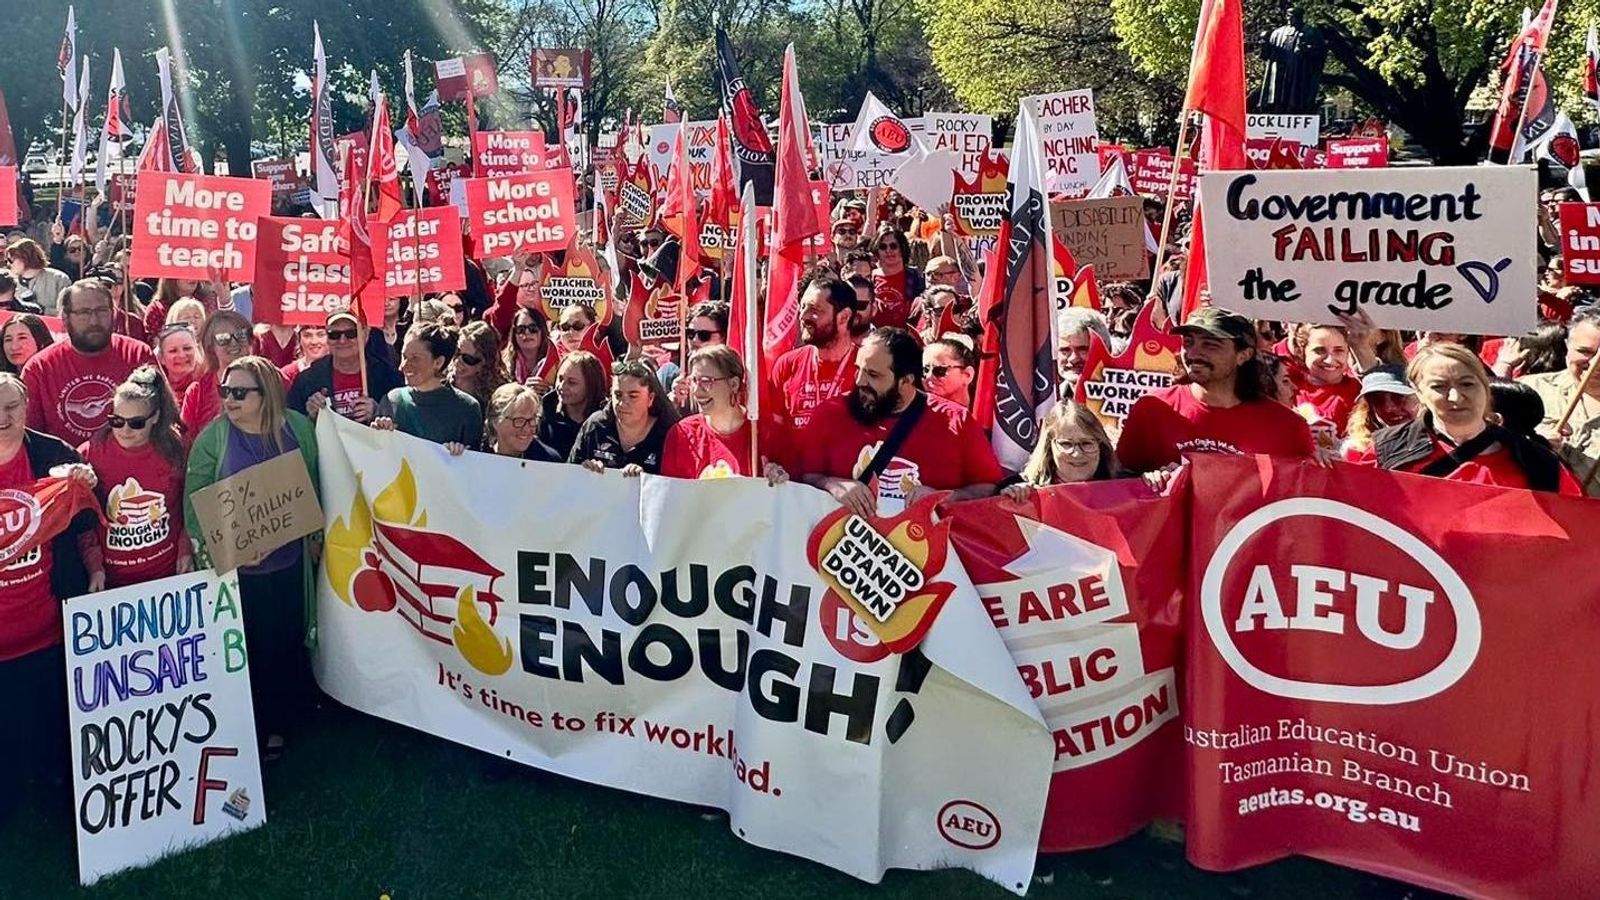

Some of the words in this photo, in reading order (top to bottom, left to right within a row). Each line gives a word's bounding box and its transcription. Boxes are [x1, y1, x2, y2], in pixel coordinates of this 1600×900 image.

[935, 118, 979, 133] ROCKY
[1044, 123, 1053, 133] BY
[1057, 121, 1075, 132] DAY
[1247, 115, 1313, 129] OCKLIFF
[487, 134, 530, 149] More
[688, 125, 716, 147] IX
[927, 132, 989, 152] AILED
[1043, 135, 1099, 158] NCHING
[479, 150, 518, 165] time
[521, 152, 539, 165] to
[1330, 142, 1381, 157] Support
[1343, 156, 1369, 166] new
[256, 163, 293, 175] Support
[433, 168, 462, 180] Safer
[1047, 157, 1078, 175] BAG
[1138, 165, 1188, 182] in-clas
[1147, 156, 1174, 168] Mor
[164, 179, 245, 212] More
[272, 182, 296, 191] chers
[487, 178, 550, 202] More
[1226, 173, 1482, 223] Government
[483, 198, 560, 225] school
[956, 195, 1004, 206] DROWN
[962, 207, 975, 216] IN
[146, 208, 219, 239] time
[225, 216, 257, 241] to
[388, 215, 440, 239] afer
[971, 217, 1001, 228] WOR
[1058, 206, 1143, 229] DISABILITY
[281, 224, 351, 253] Safe
[483, 222, 565, 254] psychs
[701, 236, 717, 245] TO
[1271, 223, 1456, 266] FAILING
[157, 242, 243, 269] teach
[387, 240, 440, 263] lass
[385, 264, 442, 287] sizes
[551, 279, 594, 288] TEACHER
[542, 288, 604, 298] WORKLOADS
[551, 298, 570, 307] ARE
[1238, 267, 1302, 302] the
[1327, 270, 1453, 316] grade
[642, 320, 678, 328] ENOUGH
[1105, 371, 1171, 388] TEACHE
[1104, 402, 1132, 415] AR
[217, 480, 256, 518] 3%
[210, 529, 224, 544] is
[247, 487, 304, 526] FAILING
[109, 523, 152, 536] ENOUGH
[235, 511, 293, 550] GRADE
[848, 518, 920, 588] UNPAID
[839, 539, 902, 599] STAND
[825, 553, 891, 618] DOWN
[516, 549, 812, 648] ENOUGH
[980, 595, 1010, 629] E
[1018, 573, 1111, 625] ARE
[1235, 564, 1435, 651] AEU
[72, 582, 208, 656] BURNOUT
[74, 633, 208, 713] UNSAFE
[223, 628, 247, 674] B
[518, 612, 934, 747] ENOUGH!
[1016, 647, 1119, 700] BLIC
[437, 663, 473, 699] It's
[479, 687, 543, 728] time
[551, 712, 586, 732] to
[594, 711, 635, 738] fix
[1053, 684, 1171, 762] ATION
[80, 693, 217, 781] ROCKY'S
[1184, 722, 1271, 750] ustralian
[1277, 718, 1419, 766] Education
[1429, 749, 1531, 792] Union
[79, 759, 182, 834] OFFER
[193, 746, 239, 826] F
[1218, 752, 1334, 784] Tasmanian
[1341, 758, 1454, 809] Branch
[1237, 787, 1422, 833] aeutas.org.au
[944, 813, 993, 837] AEU
